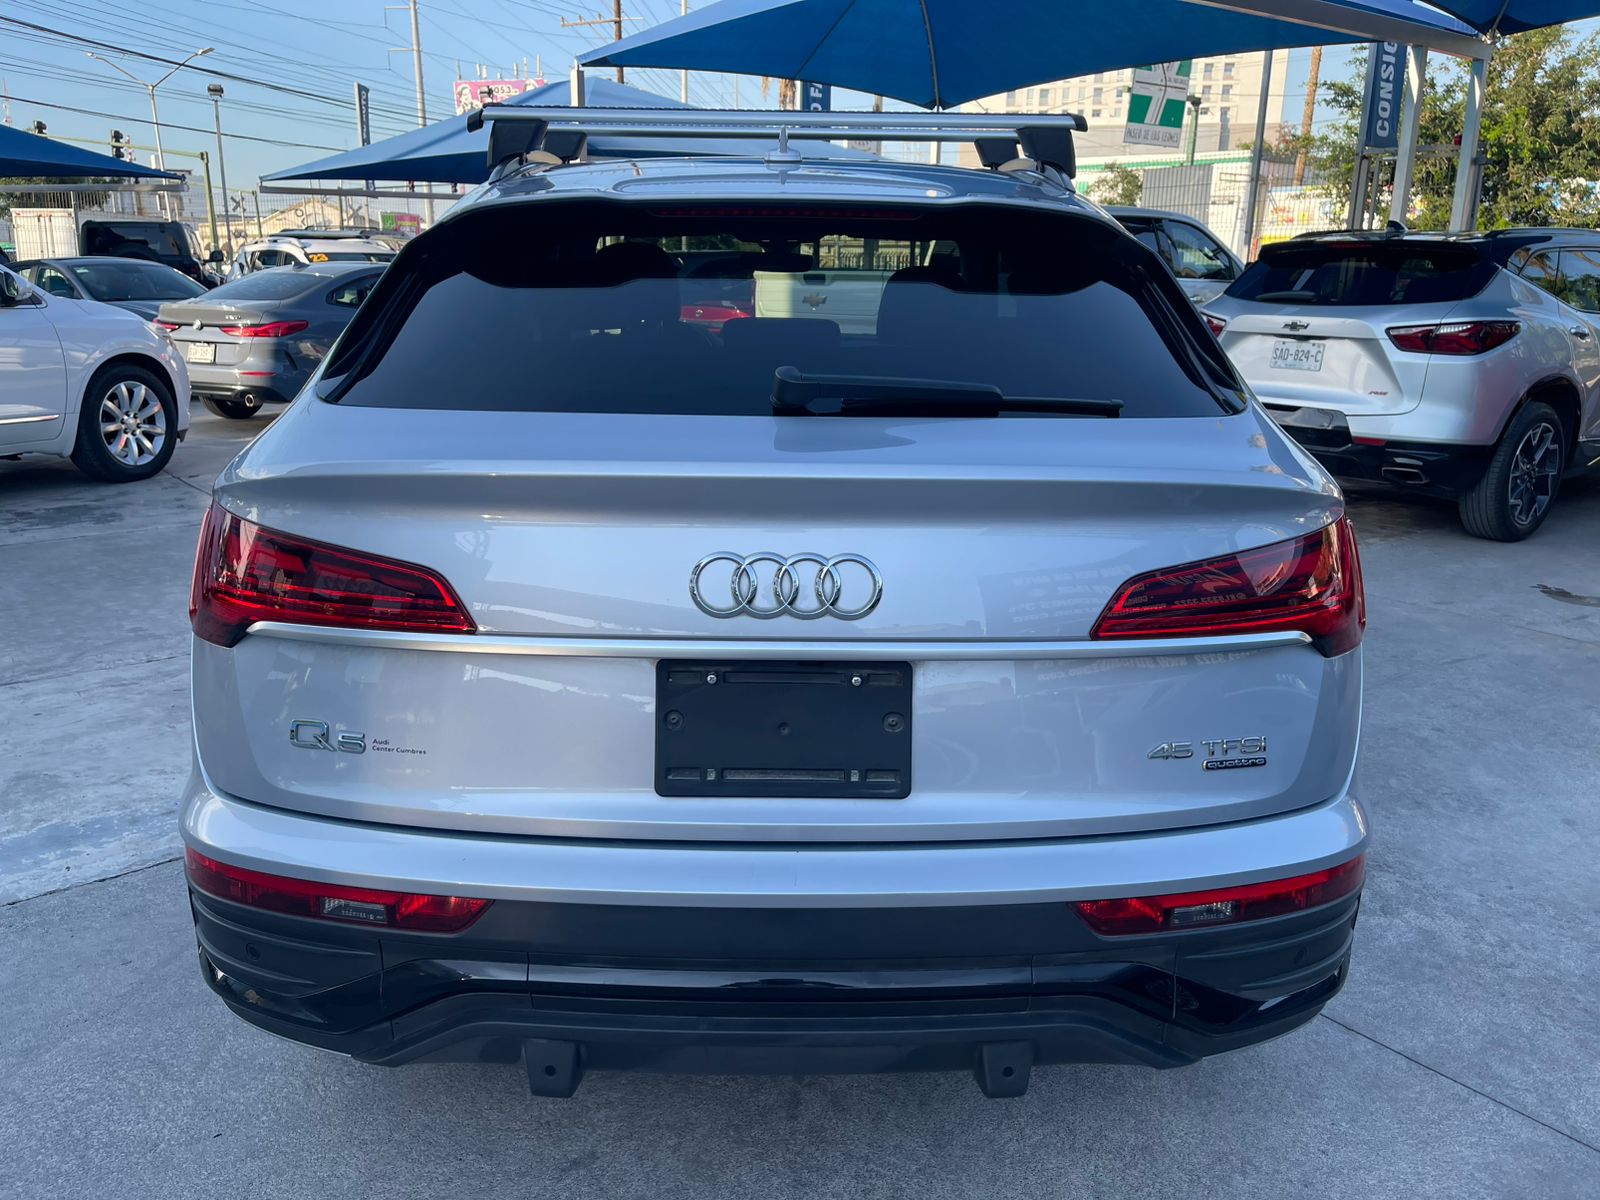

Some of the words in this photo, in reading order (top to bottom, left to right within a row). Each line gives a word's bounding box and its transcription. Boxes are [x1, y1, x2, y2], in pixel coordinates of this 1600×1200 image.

[1376, 42, 1398, 137] CONSIG
[290, 719, 367, 754] Q5
[1147, 742, 1193, 760] 45
[1201, 736, 1266, 756] TFSI
[372, 745, 395, 753] Center
[396, 746, 427, 755] Cumbres
[1206, 757, 1266, 769] quattro
